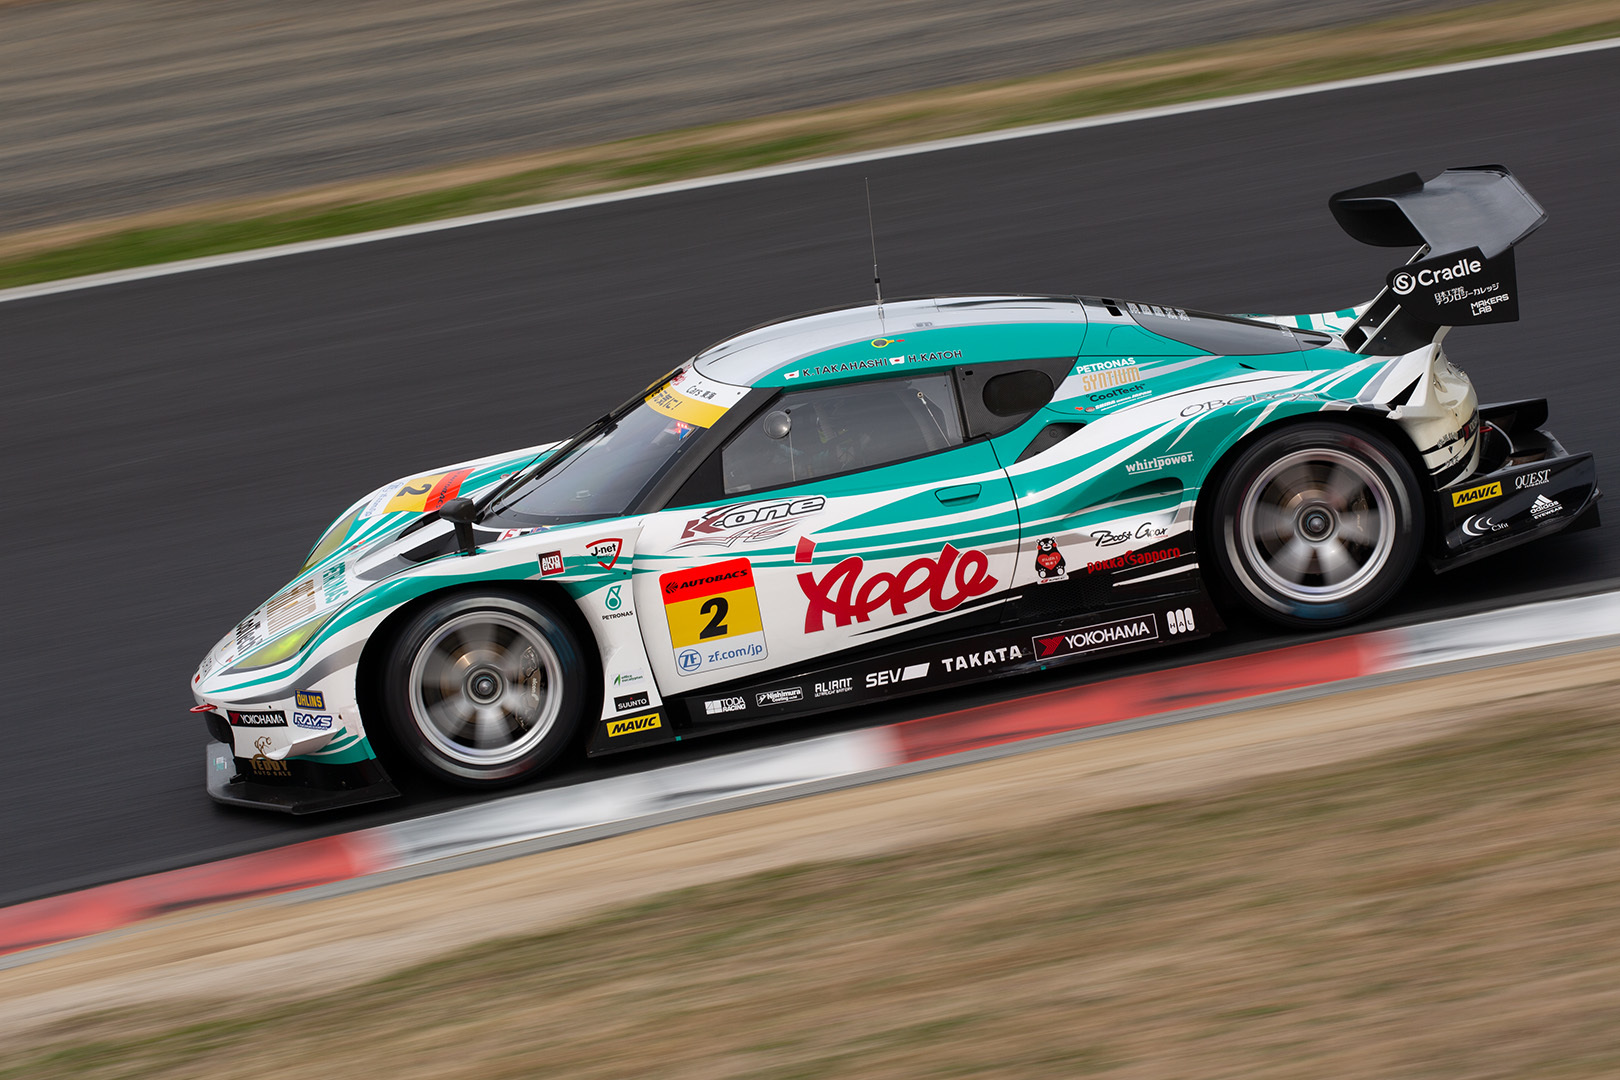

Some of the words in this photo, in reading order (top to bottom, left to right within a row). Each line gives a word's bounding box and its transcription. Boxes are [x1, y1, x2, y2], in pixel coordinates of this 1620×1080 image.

[1418, 258, 1482, 286] Cradle
[1470, 293, 1510, 310] MAKERS
[1472, 305, 1493, 316] LAB
[802, 358, 888, 377] K.TAKAHASHI
[907, 350, 963, 363] H.KATOH
[1076, 357, 1136, 374] PETRONAS
[1082, 366, 1141, 392] SYNTIUM
[1515, 469, 1551, 488] QUEST
[1456, 484, 1499, 504] MAVIC
[1530, 500, 1559, 514] adidas
[541, 555, 560, 564] AUTO
[542, 561, 562, 572] GLYM
[679, 568, 749, 591] AUTOBACS
[602, 611, 633, 620] PETRONAS
[699, 597, 729, 640] 2
[1065, 621, 1151, 650] YOKOHAMA
[680, 651, 701, 670] ZF
[707, 644, 764, 664] zf.com/jp
[941, 645, 1023, 673] TAKATA
[866, 668, 905, 688] SEV
[721, 696, 745, 708] TODA
[767, 689, 801, 700] Nishimura
[618, 698, 647, 710] SUUNTO
[723, 703, 746, 712] RACING
[240, 714, 285, 724] YOKOHAMA
[294, 713, 332, 727] RAYS
[612, 716, 657, 734] MAVIC
